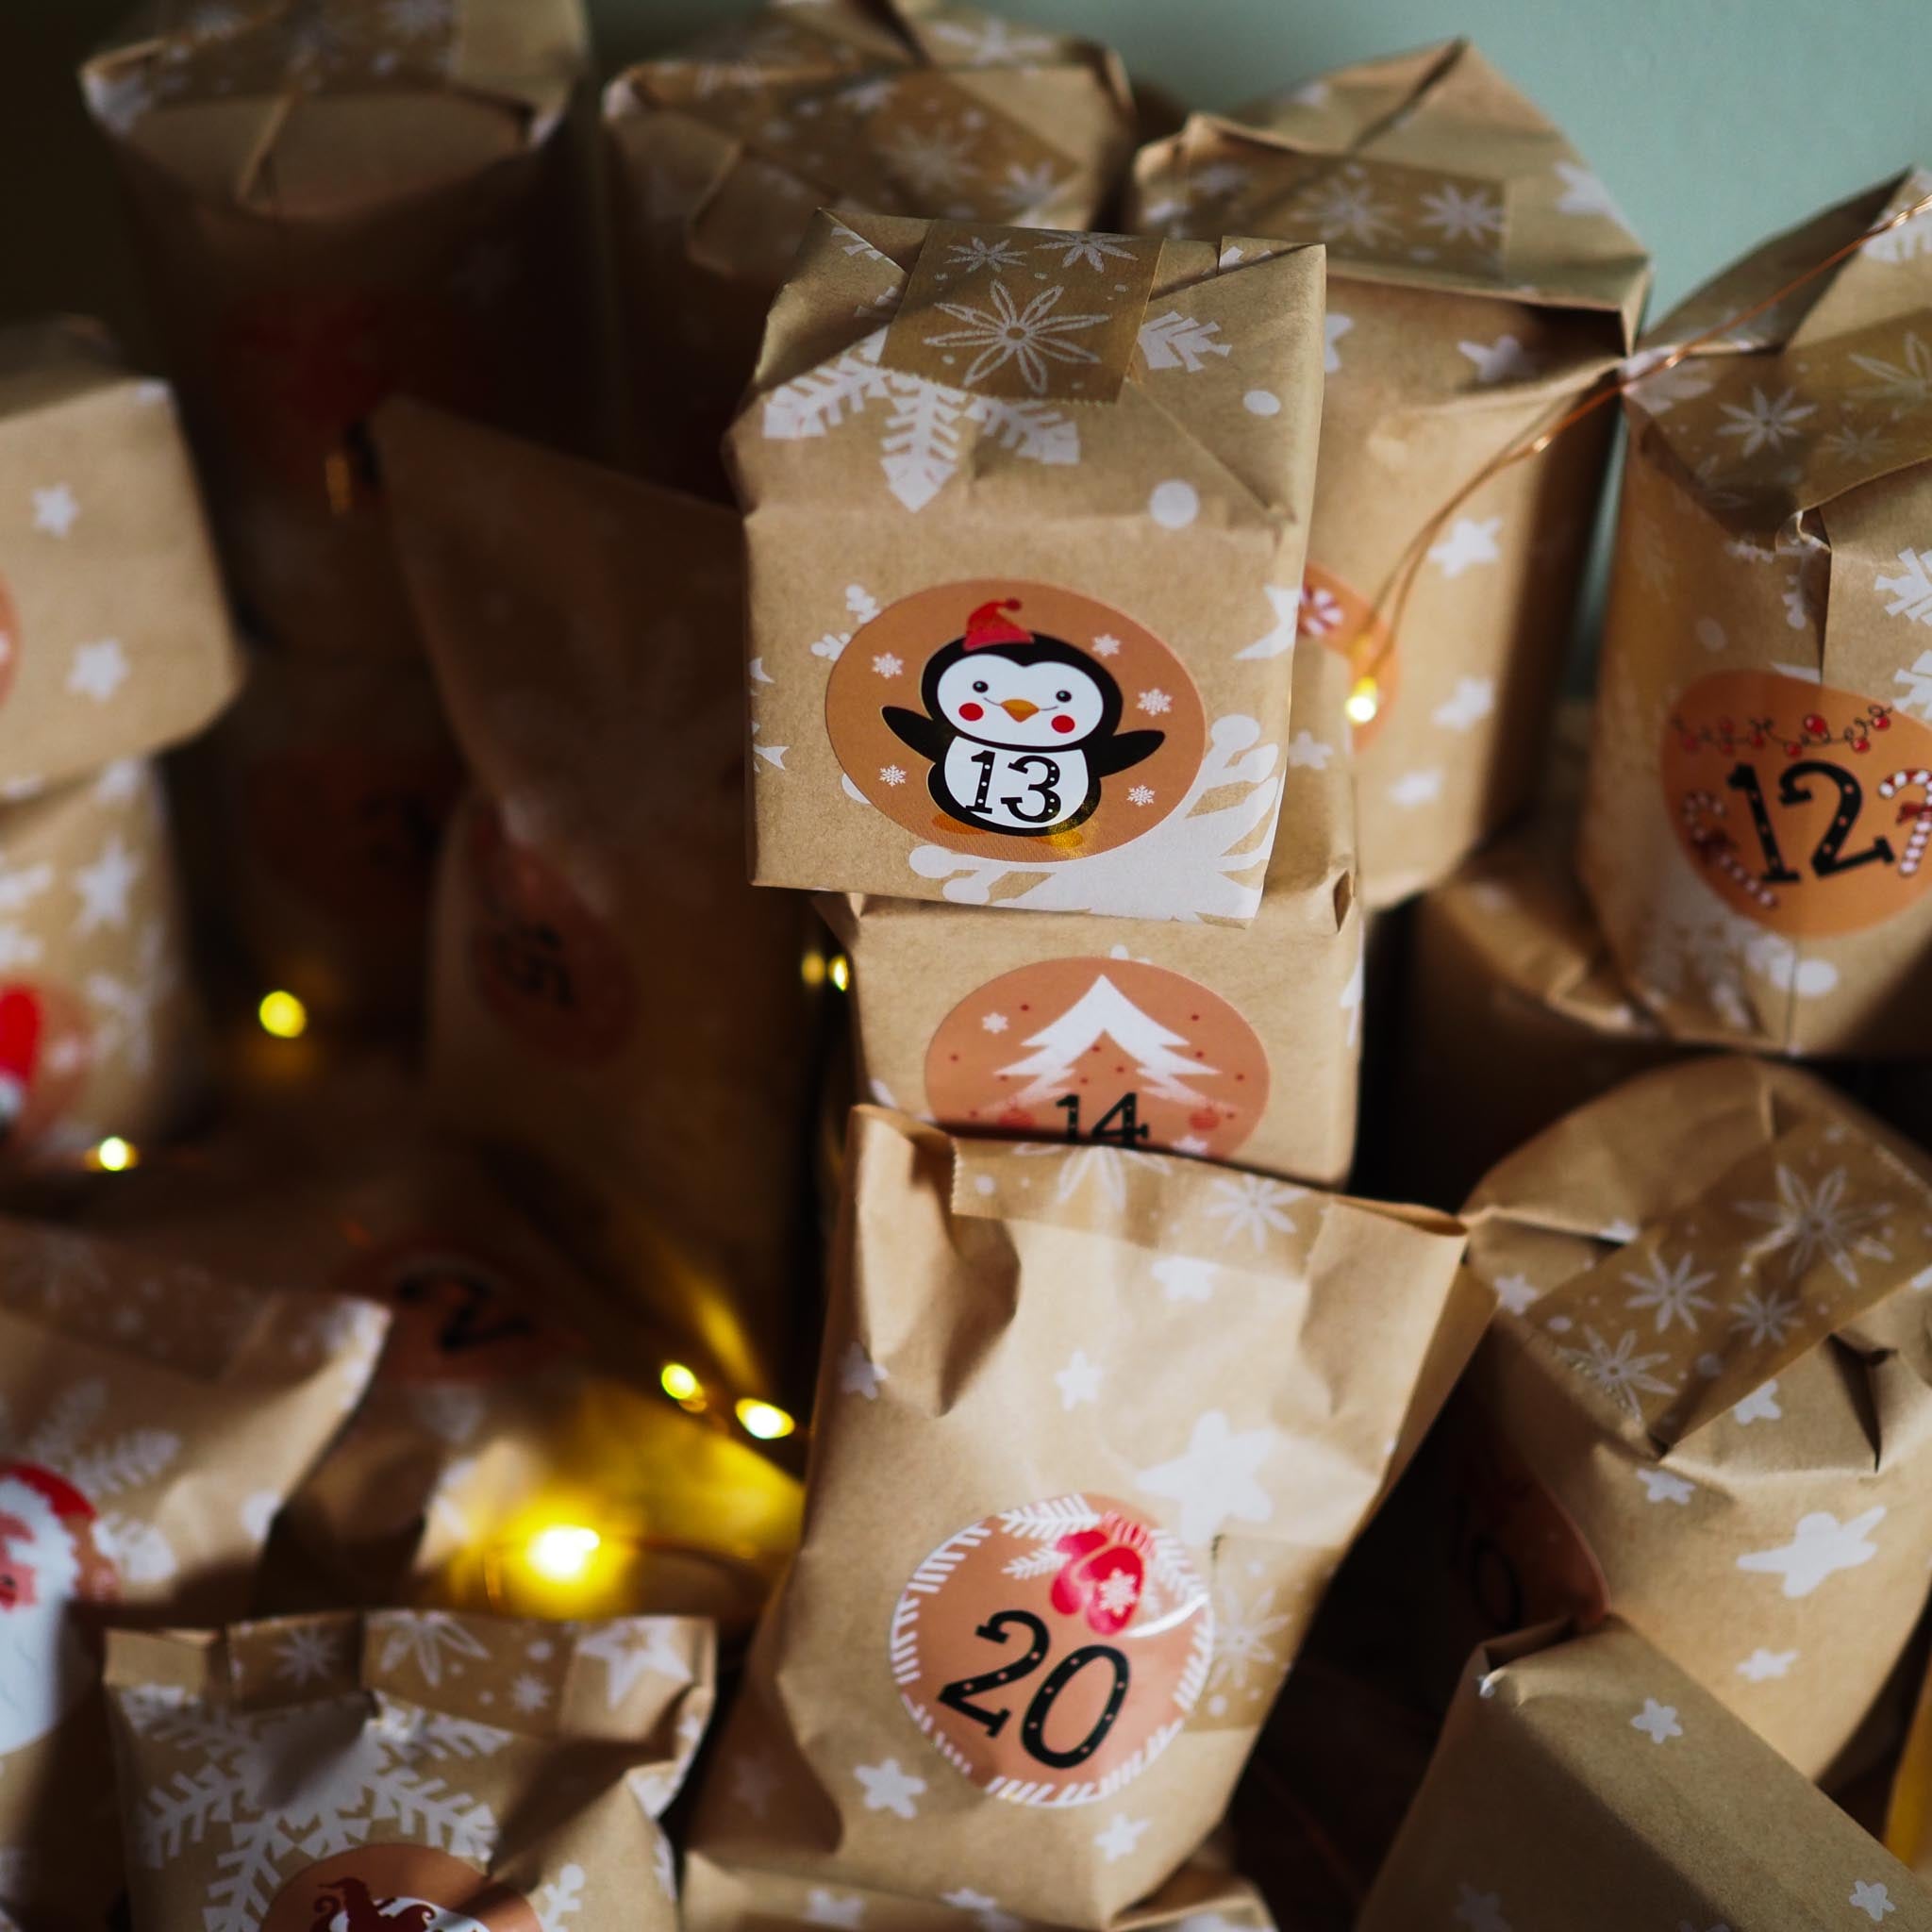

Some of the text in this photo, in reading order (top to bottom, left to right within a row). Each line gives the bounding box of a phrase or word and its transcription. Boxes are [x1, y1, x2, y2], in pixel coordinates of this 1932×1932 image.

[965, 749, 1061, 824] 13
[1726, 759, 1894, 882] 12
[1056, 1092, 1149, 1148] 14
[938, 1609, 1129, 1769] 20
